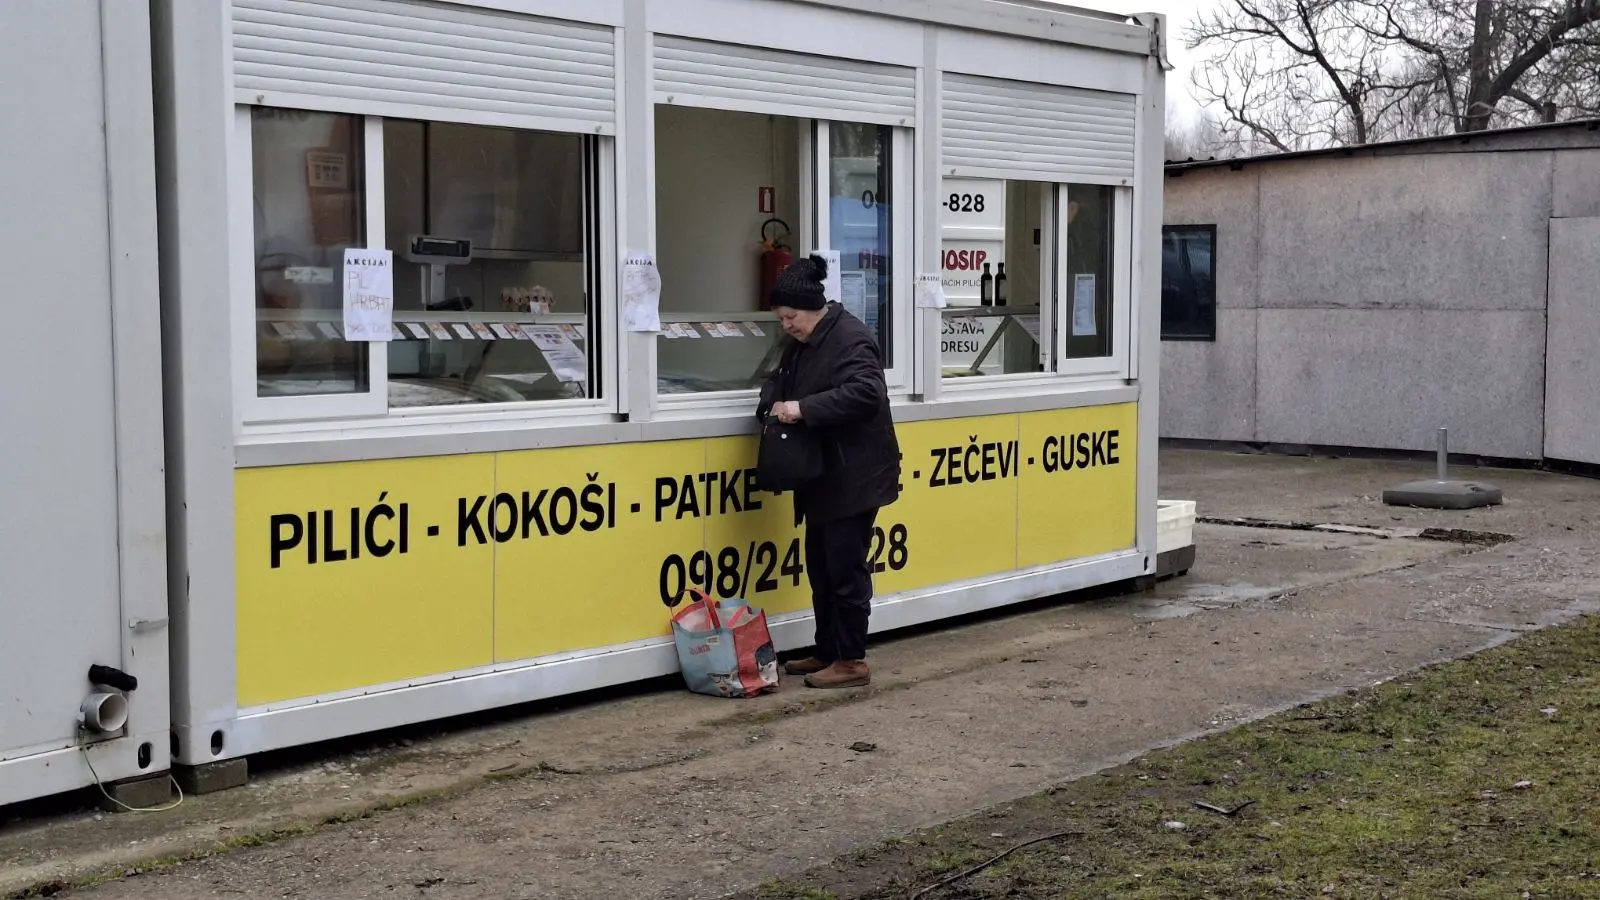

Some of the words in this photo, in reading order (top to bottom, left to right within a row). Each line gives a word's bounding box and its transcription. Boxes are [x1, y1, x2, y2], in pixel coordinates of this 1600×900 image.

[270, 491, 409, 569] PILIĆI
[457, 472, 616, 547] KOKOŠI
[654, 468, 762, 523] PATKE
[929, 434, 1019, 488] ZEČEVI
[1042, 429, 1120, 473] GUSKE
